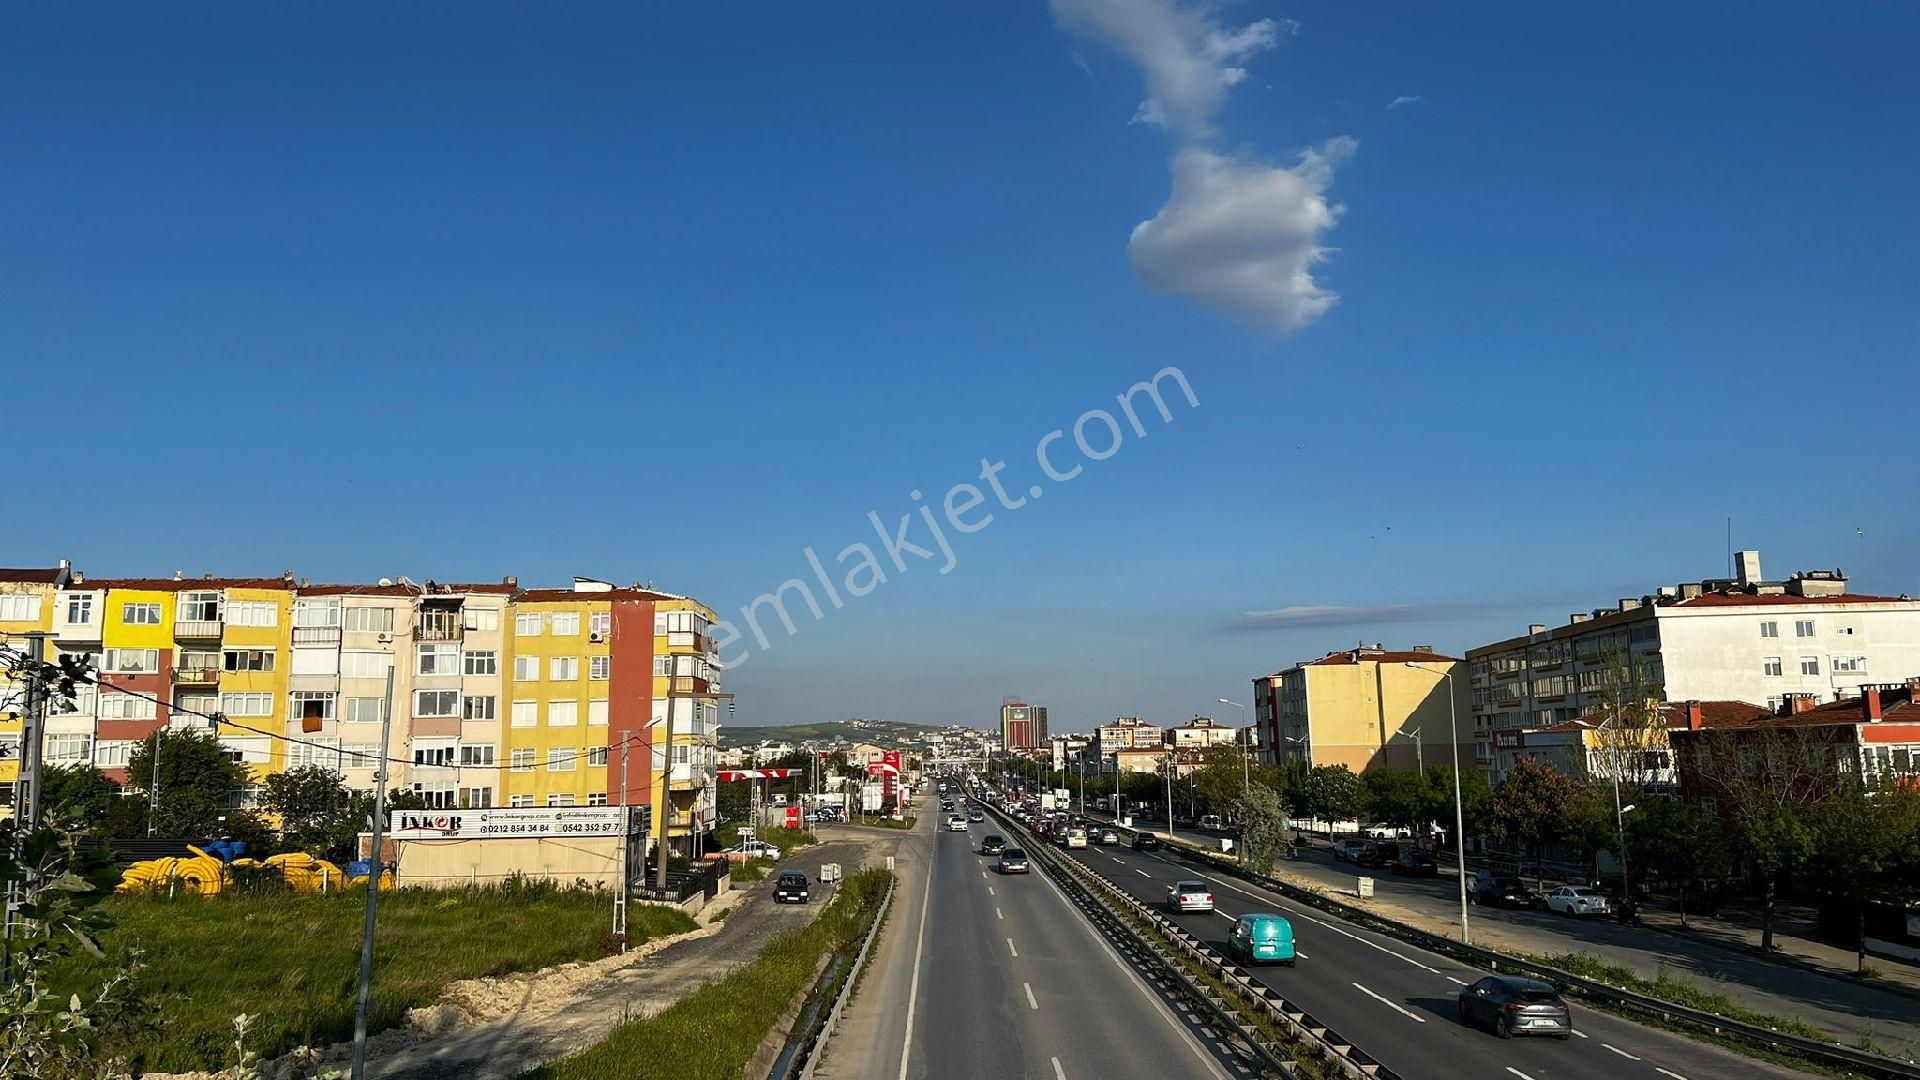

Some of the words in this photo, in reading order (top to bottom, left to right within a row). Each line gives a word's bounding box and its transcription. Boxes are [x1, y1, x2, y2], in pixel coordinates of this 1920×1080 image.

[488, 825, 508, 833] 0212
[510, 825, 525, 833] 854
[527, 824, 537, 832] 34
[540, 824, 549, 832] 84
[562, 823, 582, 832] 0542
[585, 823, 600, 832] 352
[602, 823, 612, 832] 57
